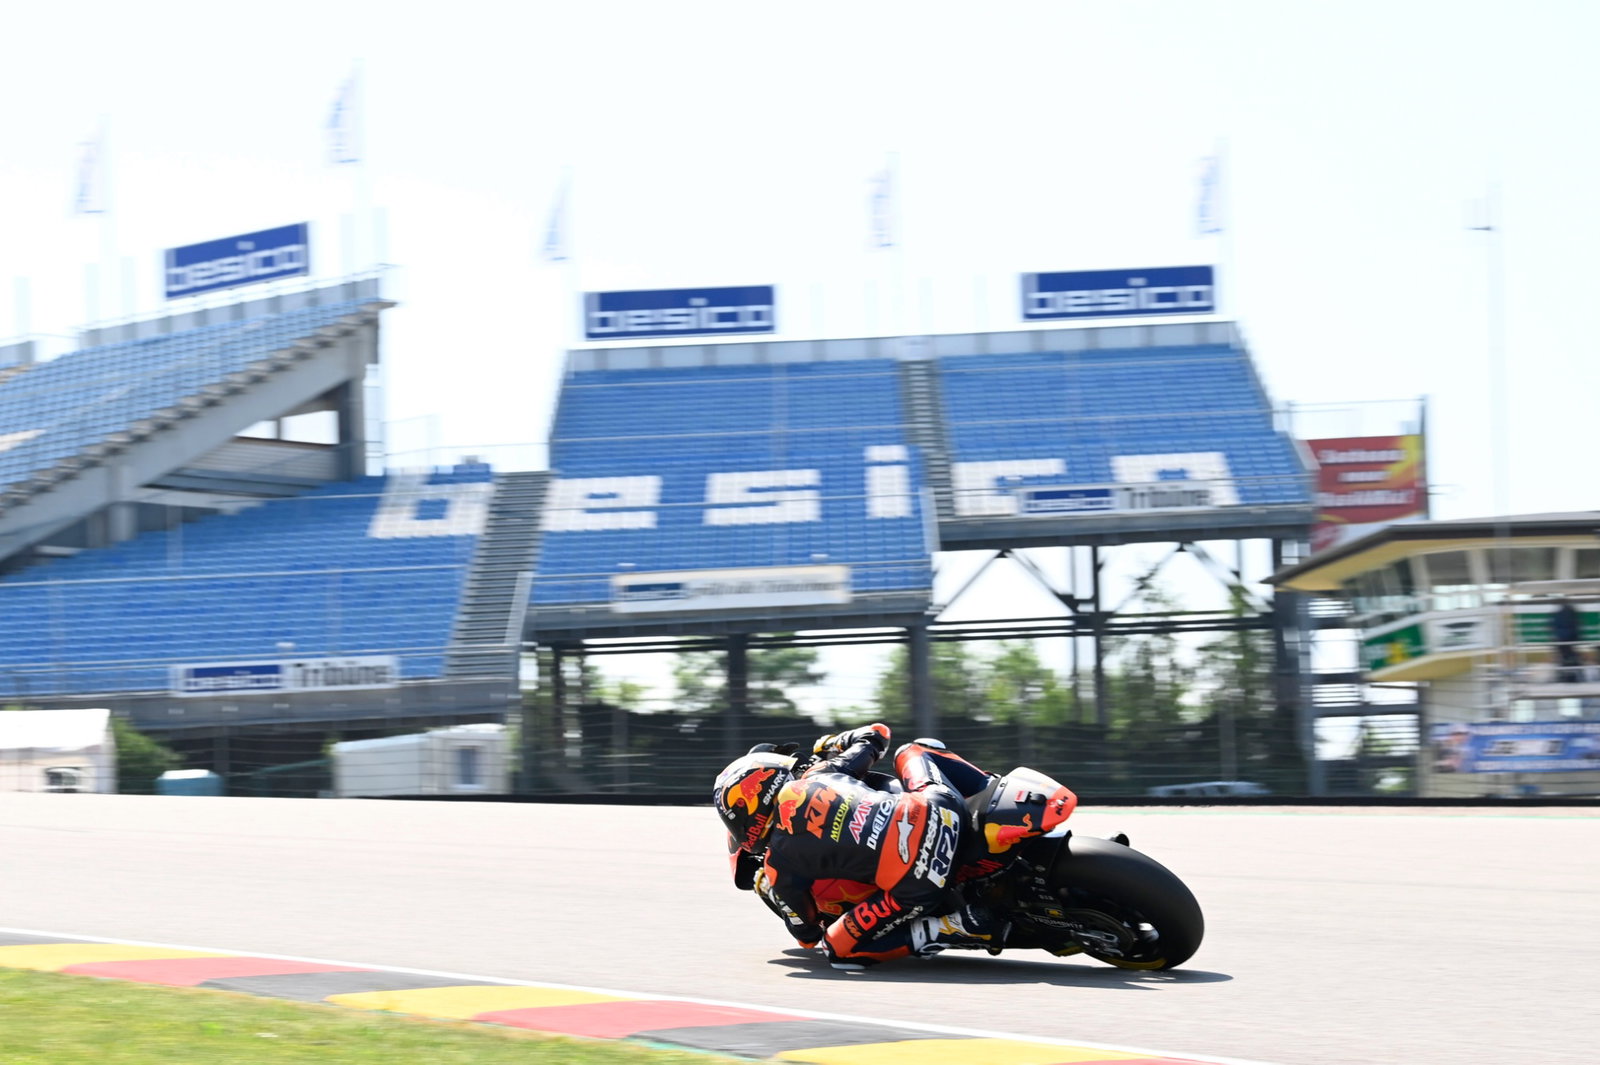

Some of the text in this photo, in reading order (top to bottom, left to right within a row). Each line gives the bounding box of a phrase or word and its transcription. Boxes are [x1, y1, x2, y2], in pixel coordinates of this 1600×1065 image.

[762, 769, 786, 805] SHARK
[748, 813, 768, 836] Bull
[804, 786, 836, 839] KTM
